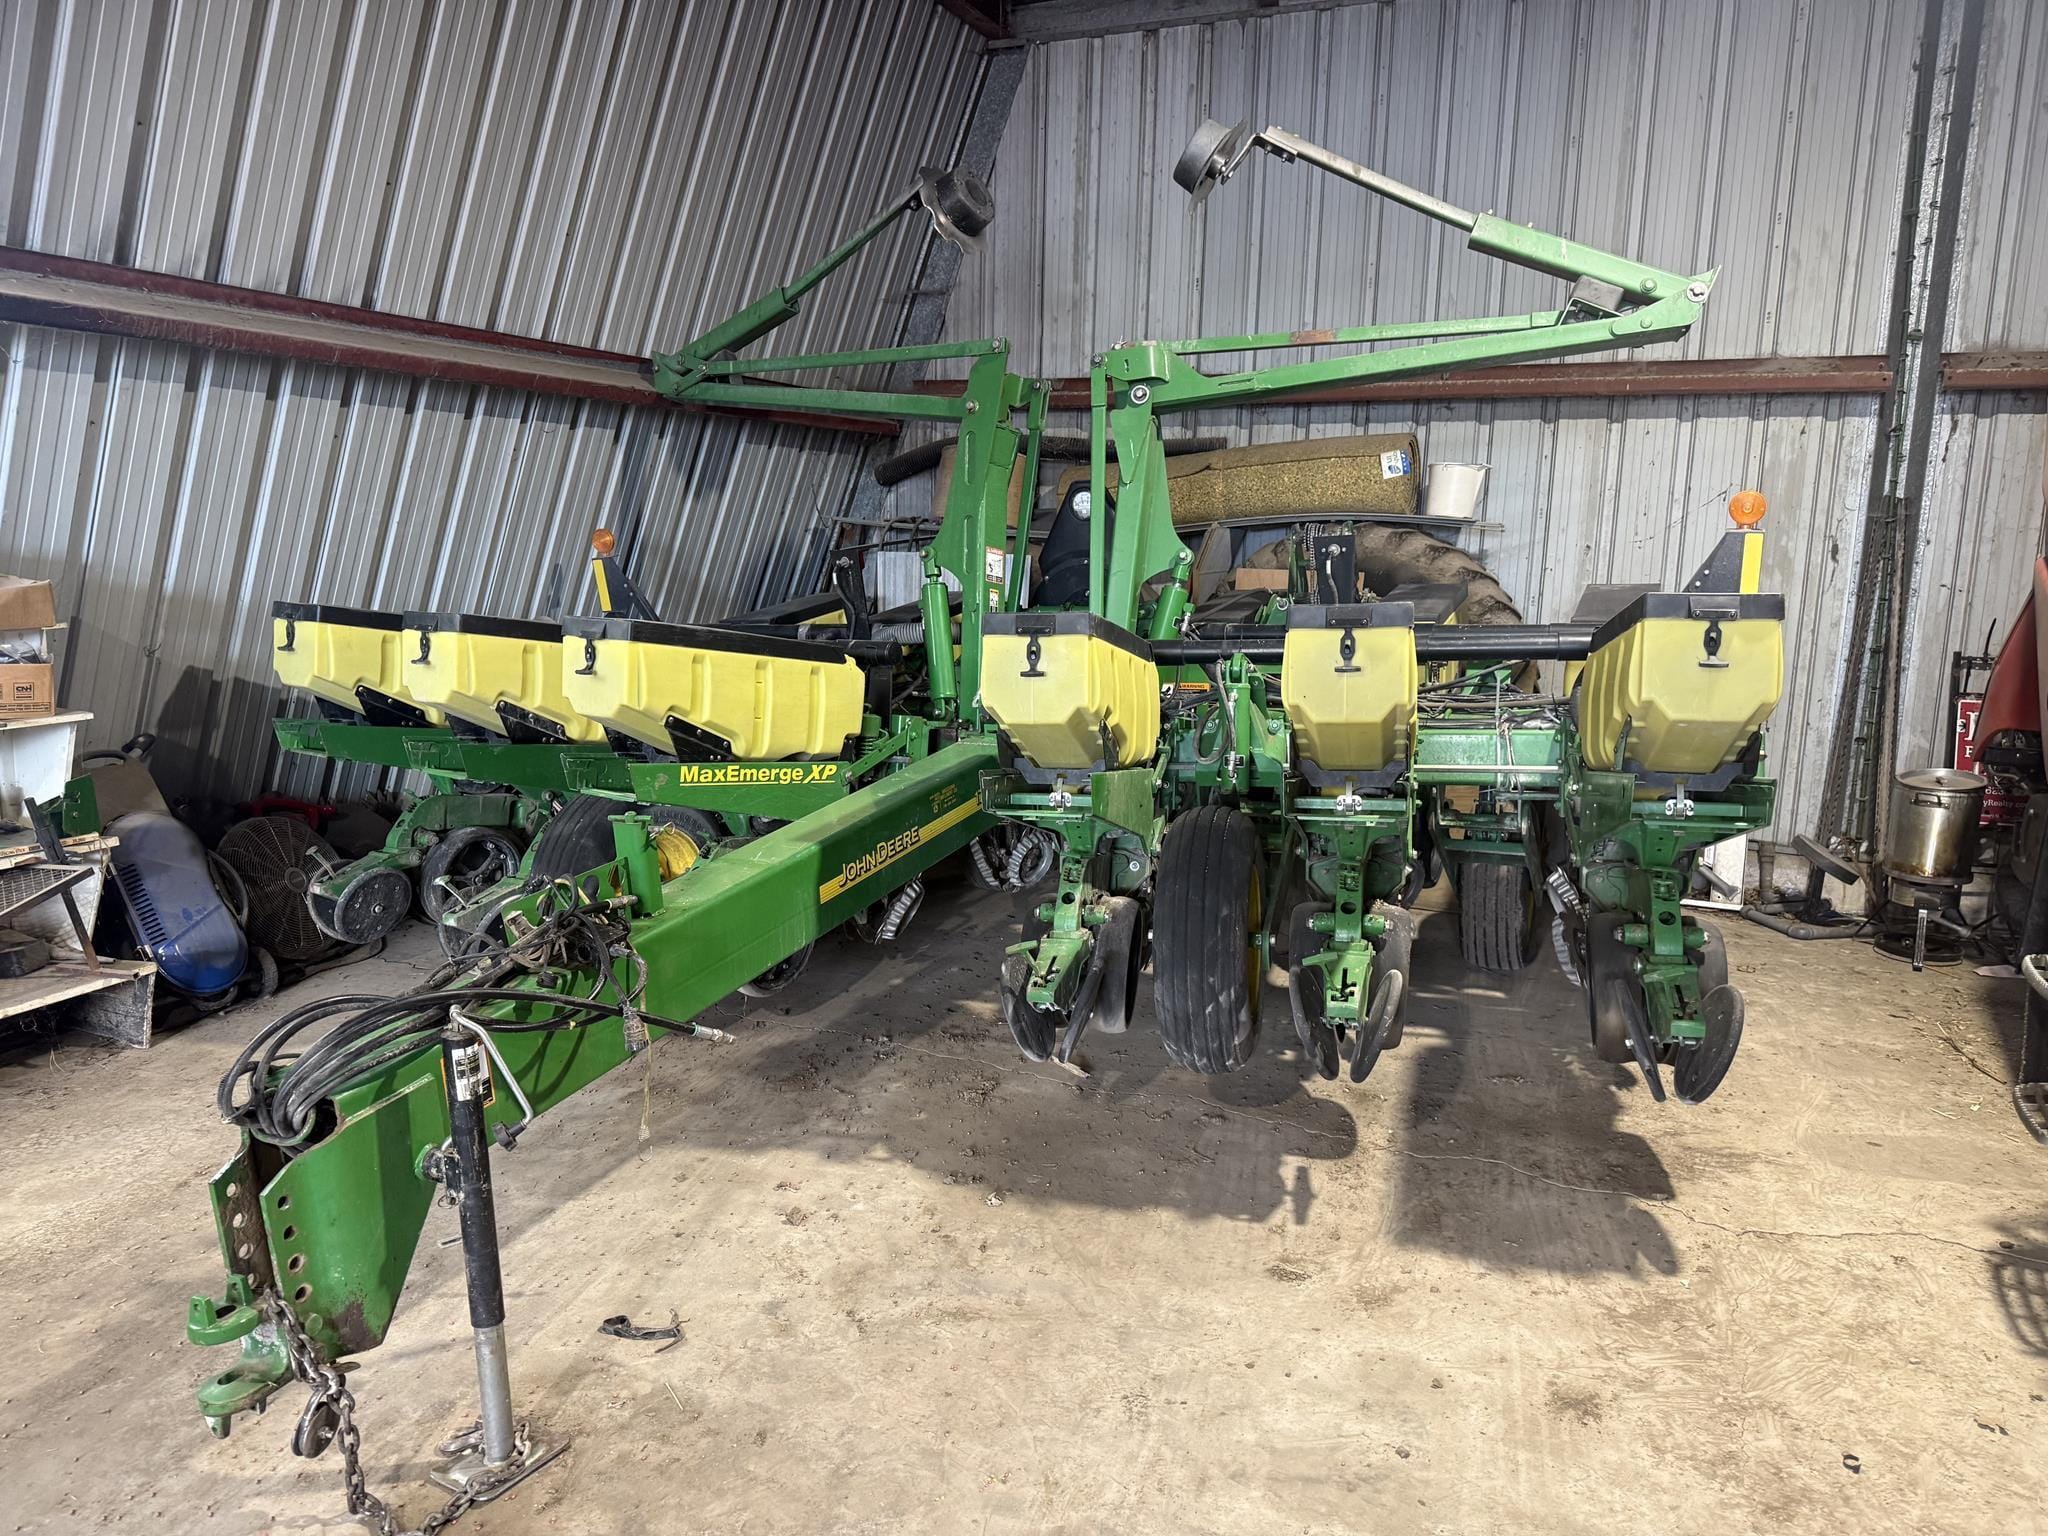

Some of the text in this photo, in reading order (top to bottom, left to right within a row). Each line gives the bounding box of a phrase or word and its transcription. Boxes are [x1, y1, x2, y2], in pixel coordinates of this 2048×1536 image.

[680, 764, 838, 784] MaxEmerge XP
[839, 825, 920, 887] JOHN DEERE
